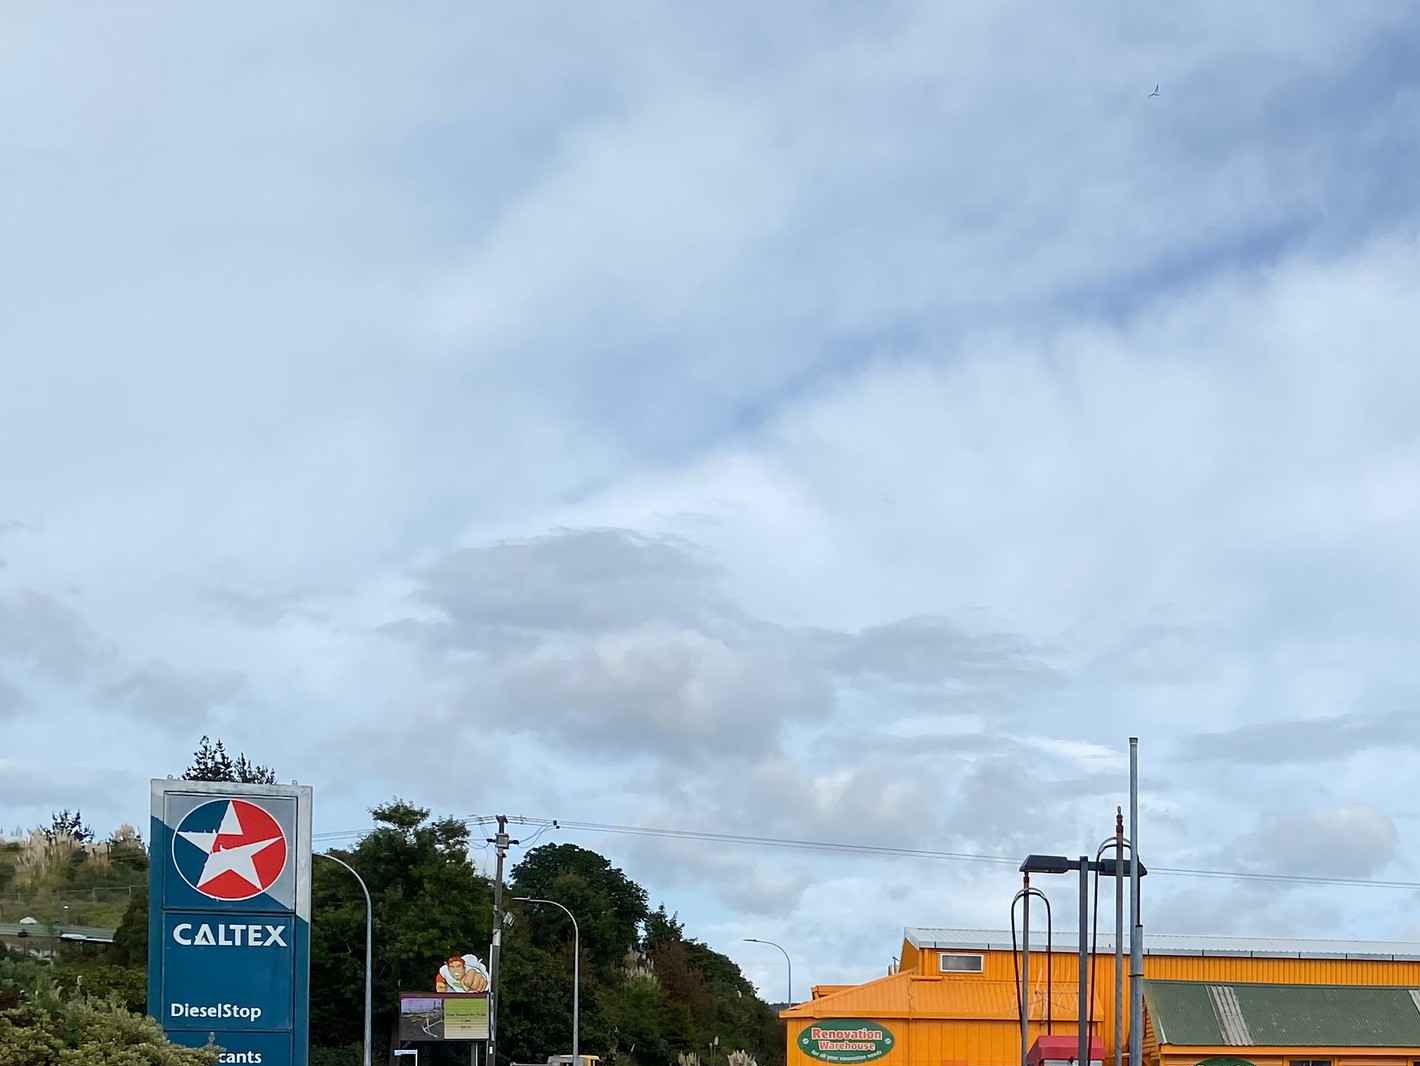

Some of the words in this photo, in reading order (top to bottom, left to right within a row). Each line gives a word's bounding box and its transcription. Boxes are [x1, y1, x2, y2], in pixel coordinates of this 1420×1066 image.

[173, 923, 287, 947] CALTEX
[170, 1003, 261, 1021] DieselStop
[811, 1028, 882, 1040] Renovation
[818, 1041, 875, 1050] Warehouse
[218, 1051, 262, 1064] cants
